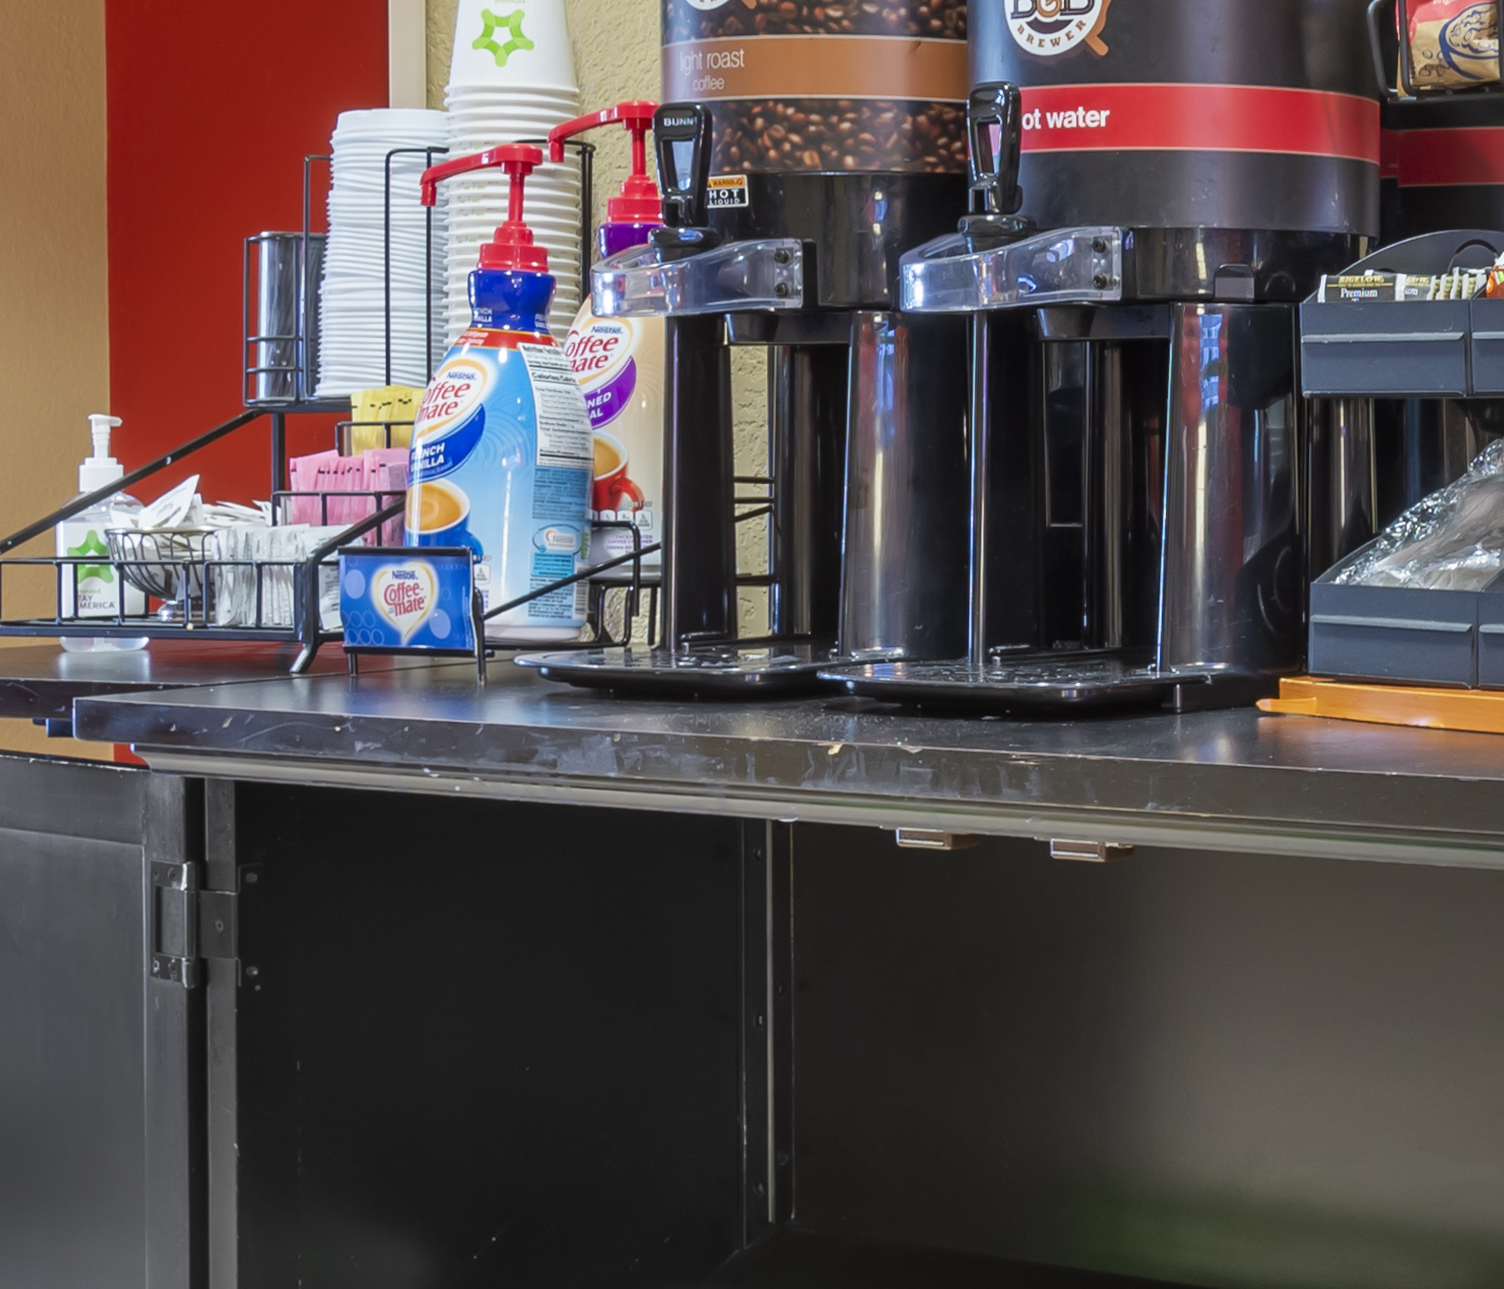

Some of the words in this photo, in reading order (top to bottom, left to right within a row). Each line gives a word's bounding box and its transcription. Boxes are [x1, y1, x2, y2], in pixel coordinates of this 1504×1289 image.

[1017, 20, 1086, 48] BREWER
[707, 48, 745, 69] roast
[692, 75, 725, 91] coffee
[663, 117, 693, 127] BUNN
[1021, 109, 1041, 130] ot
[1046, 106, 1110, 129] water
[708, 189, 739, 199] HOT
[1340, 287, 1378, 298] Premium
[80, 601, 115, 609] MERICA
[394, 595, 427, 617] mate
